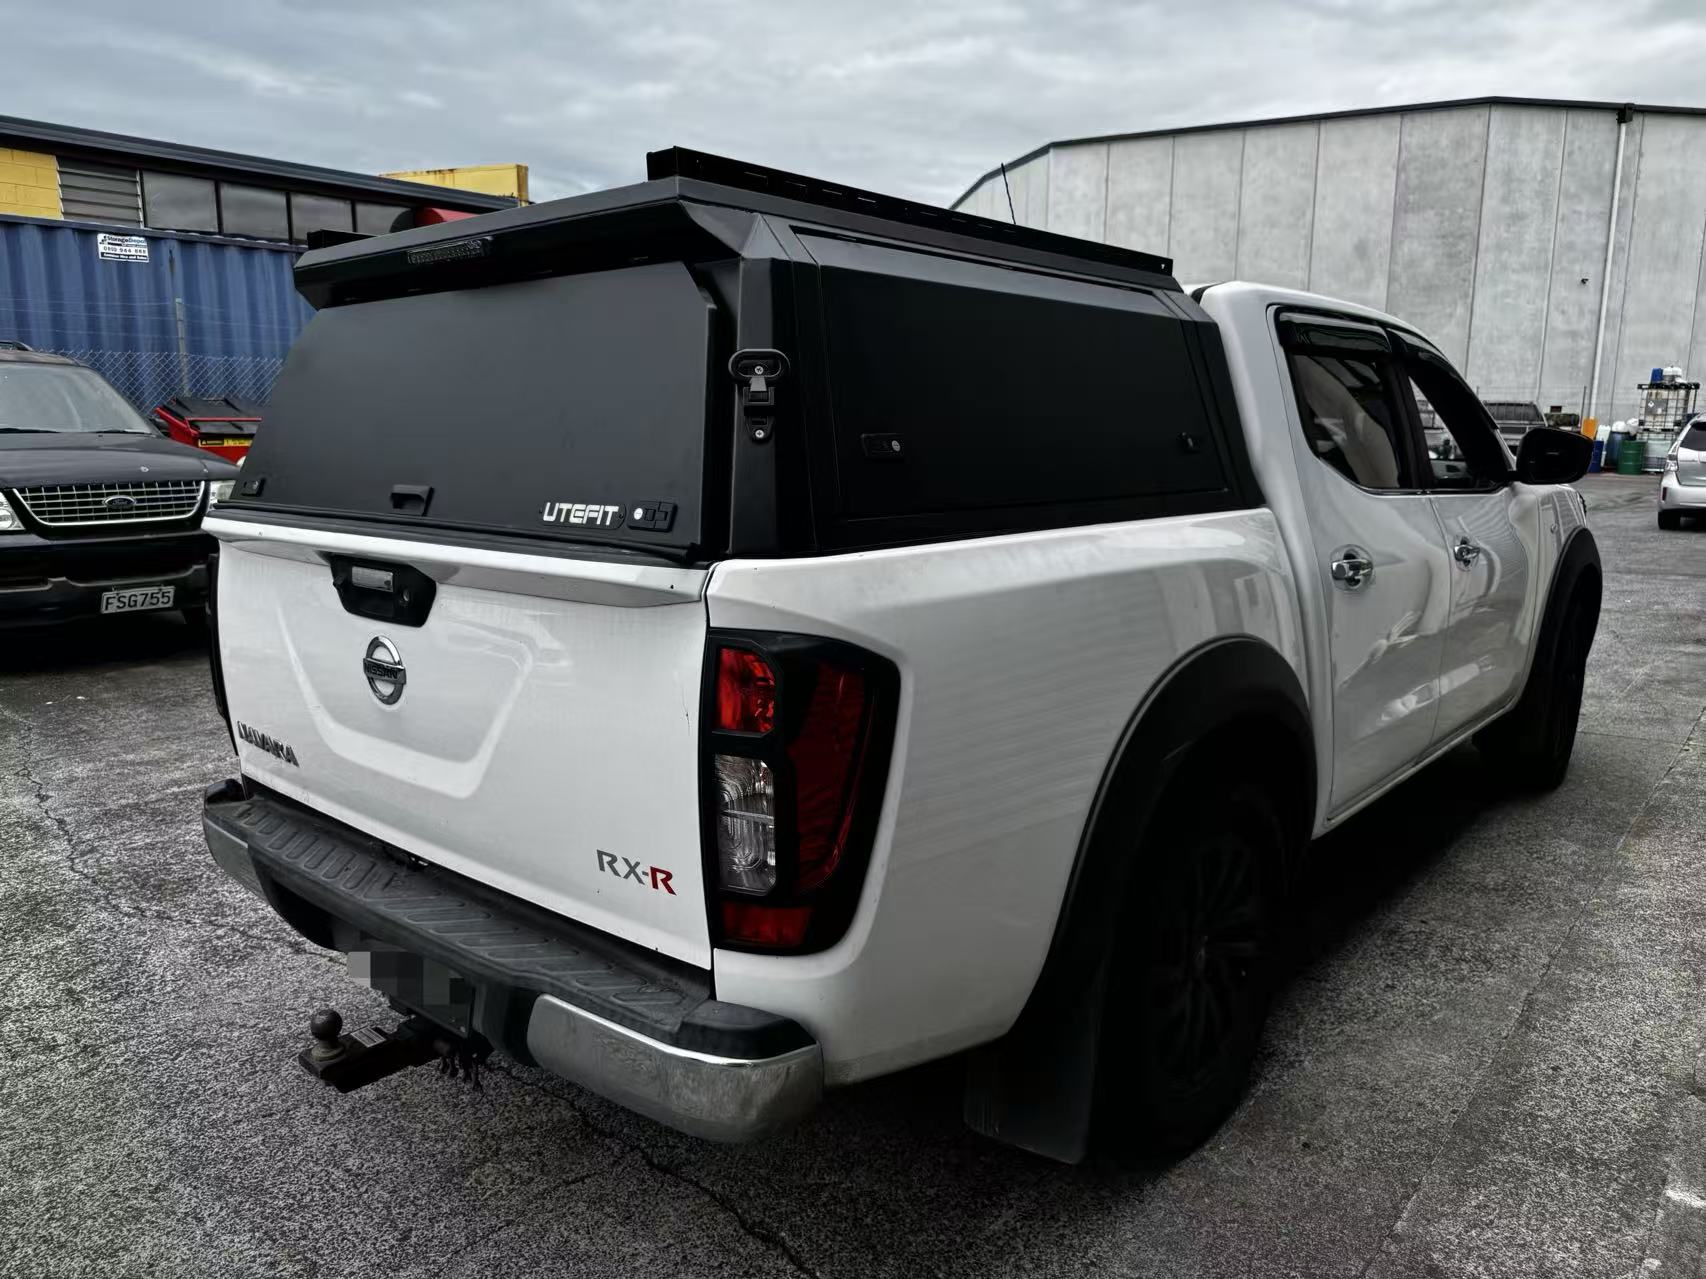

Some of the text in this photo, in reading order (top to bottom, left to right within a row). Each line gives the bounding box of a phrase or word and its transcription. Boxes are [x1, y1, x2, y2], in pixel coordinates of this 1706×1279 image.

[543, 502, 619, 526] UTEFIT
[105, 591, 171, 611] FSG755
[364, 661, 399, 680] NISSAN
[596, 849, 677, 896] RX-R
